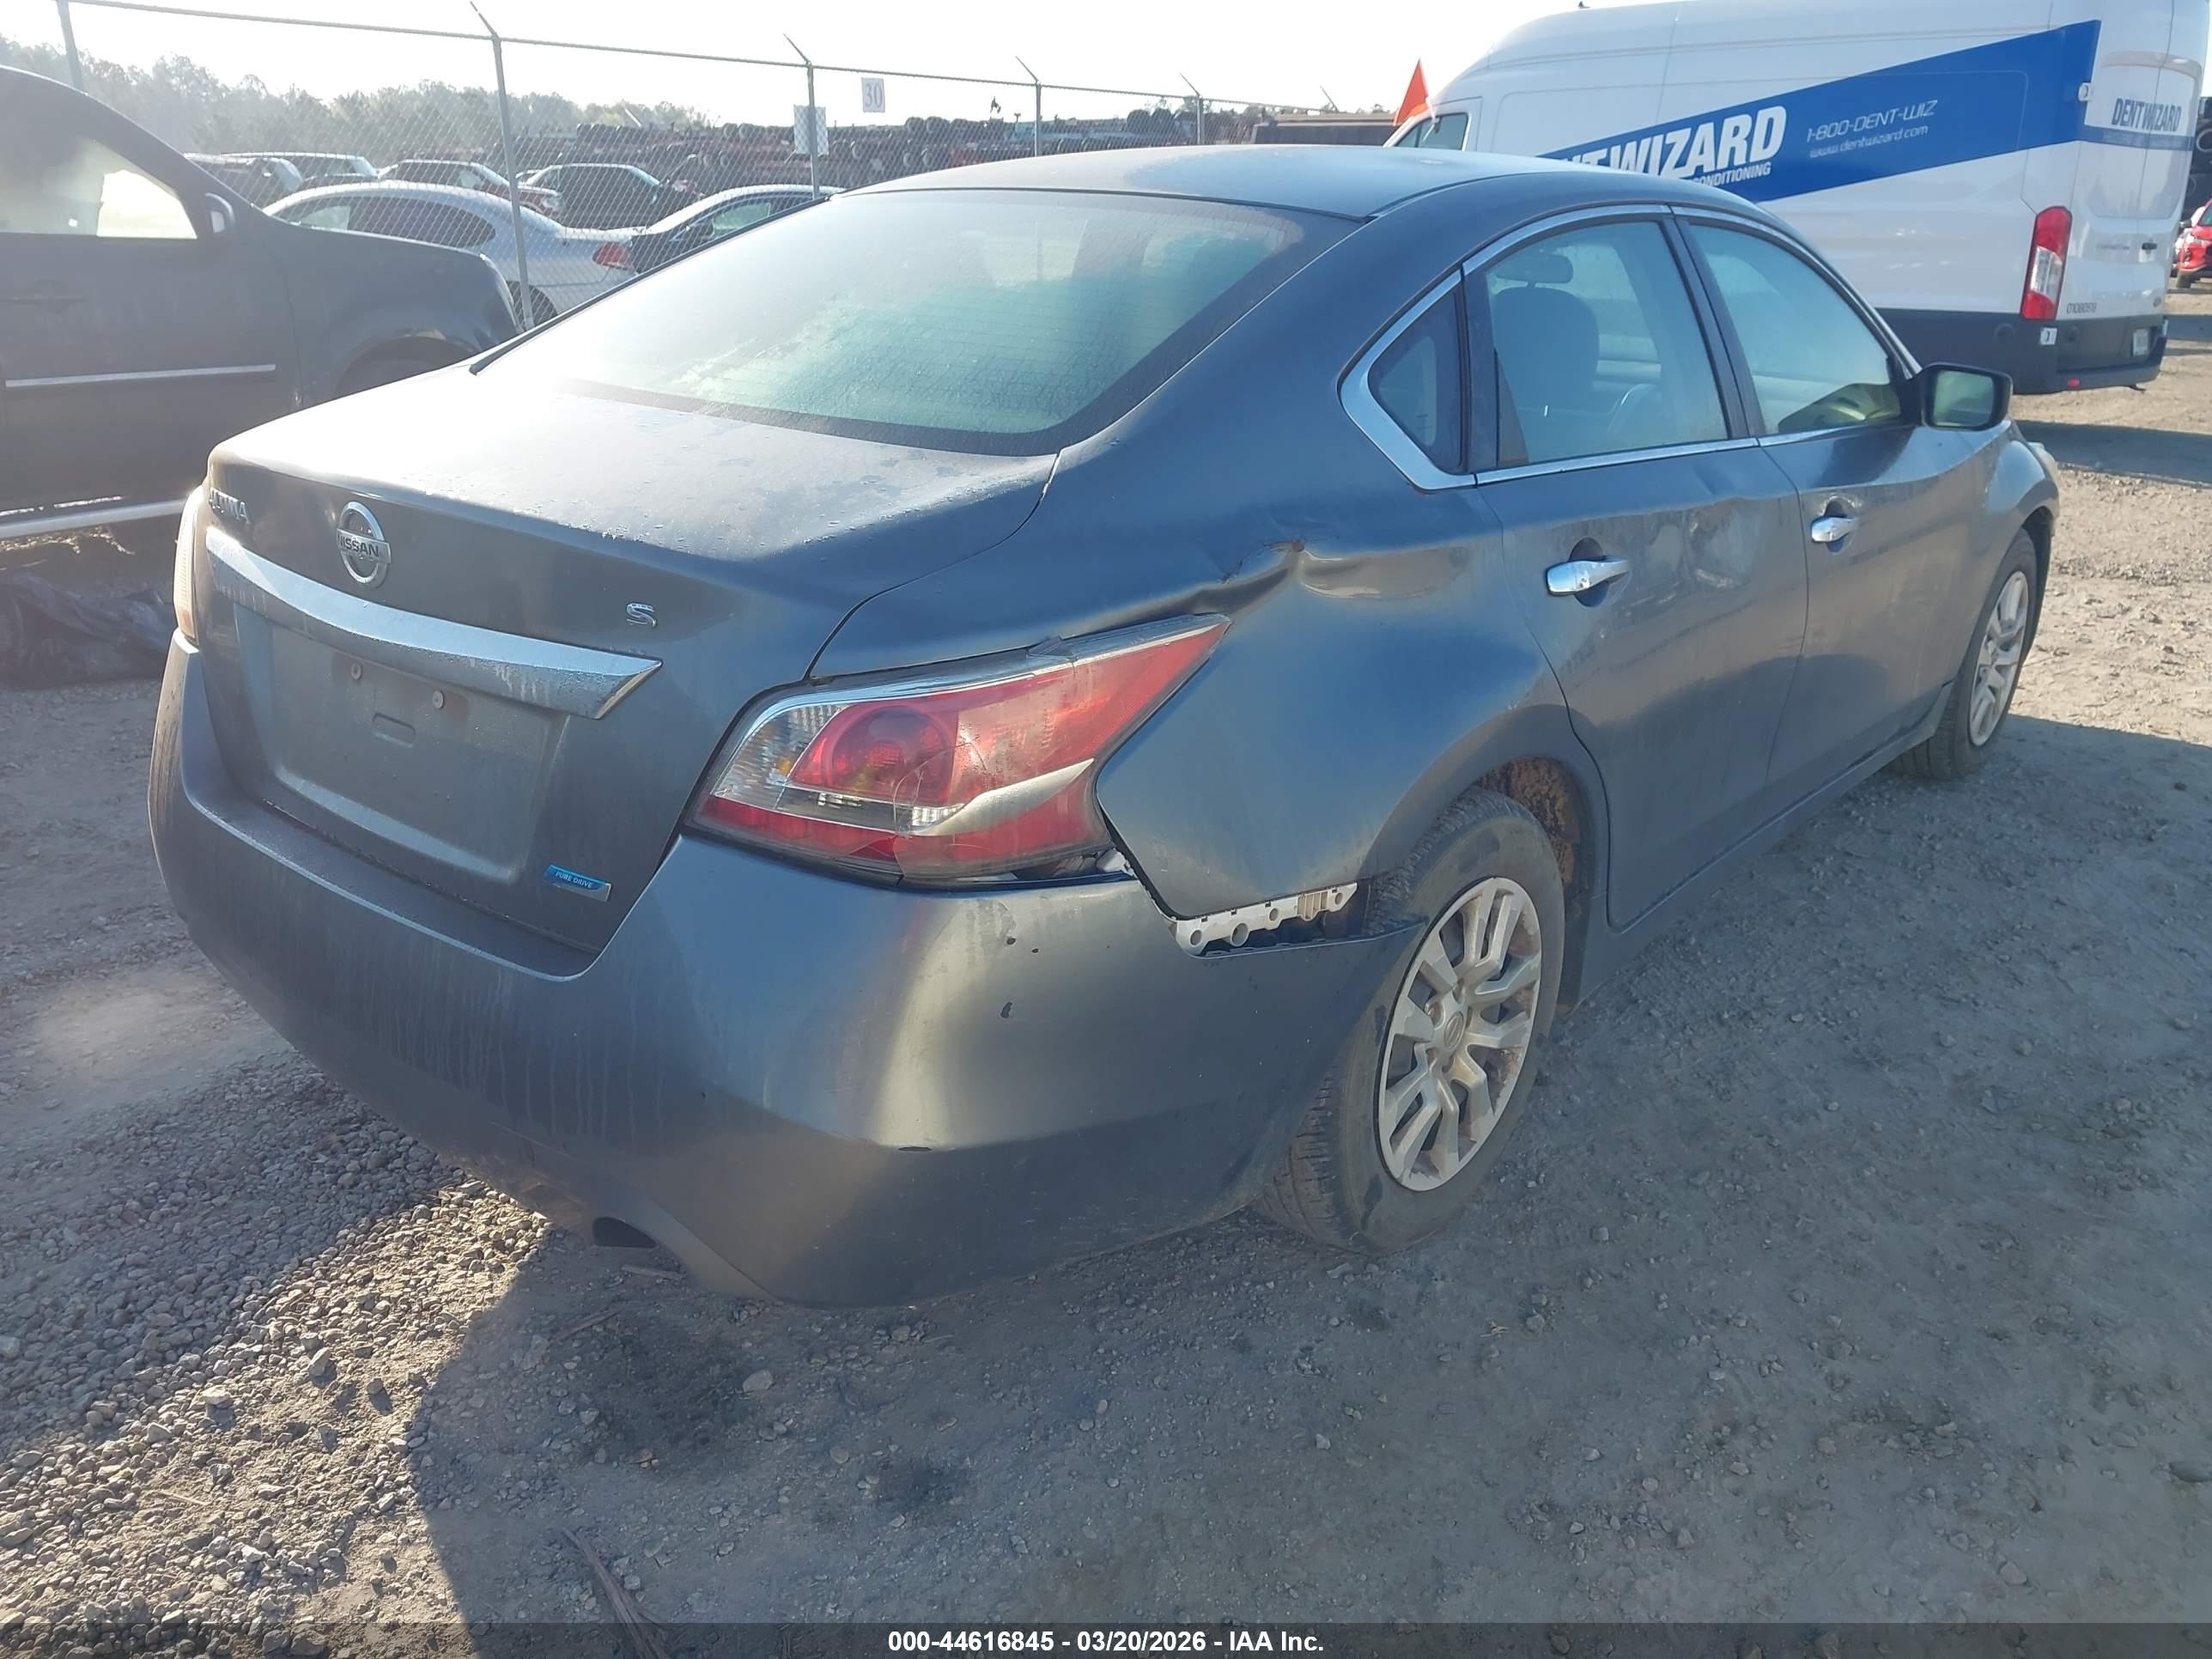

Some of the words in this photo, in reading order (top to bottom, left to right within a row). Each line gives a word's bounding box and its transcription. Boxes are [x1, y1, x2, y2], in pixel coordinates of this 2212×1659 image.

[865, 82, 883, 108] 30
[1807, 100, 1938, 143] 1-800-DENT-WIZ
[337, 533, 380, 558] NISSAN
[626, 602, 657, 628] S
[555, 871, 573, 881] PURE
[573, 877, 593, 888] DRIVE
